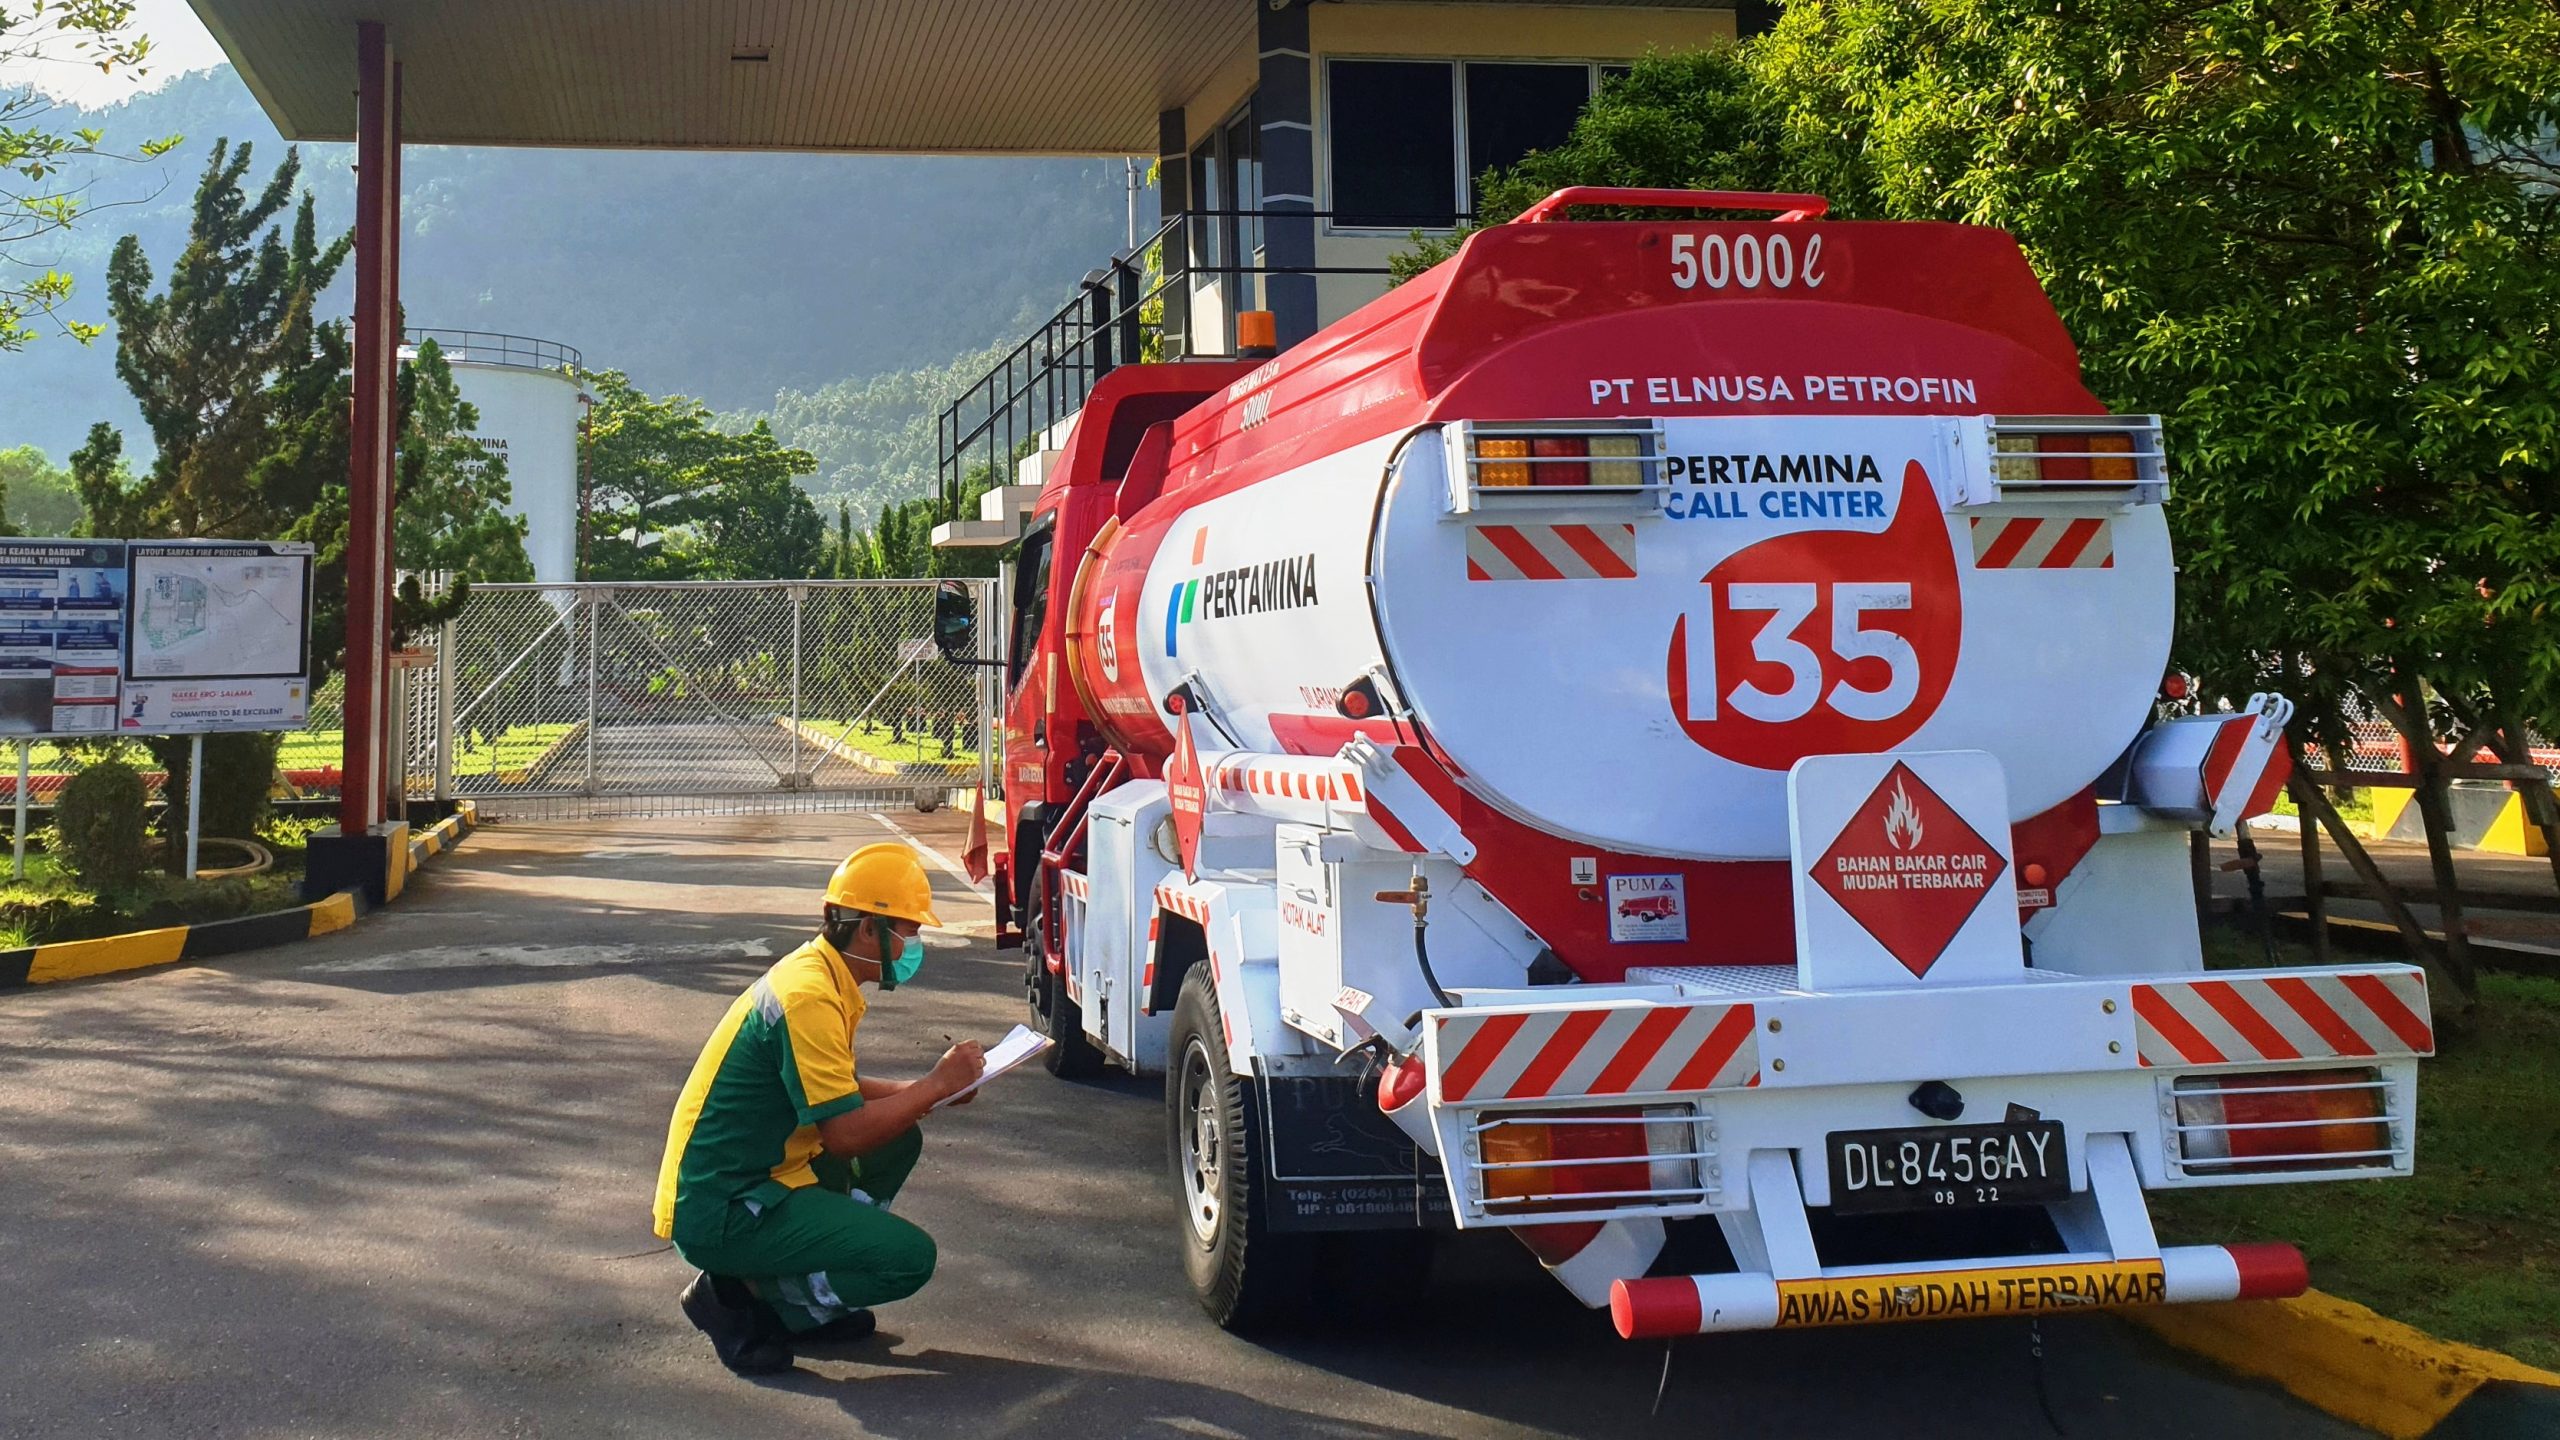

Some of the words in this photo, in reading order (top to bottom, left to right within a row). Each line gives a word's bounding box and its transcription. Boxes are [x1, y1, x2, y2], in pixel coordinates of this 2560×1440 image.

[1590, 378, 1634, 404] PT
[1647, 376, 1794, 403] ELNUSA
[1804, 375, 1977, 404] PETROFIN
[1666, 454, 1883, 485] PERTAMINA
[1664, 491, 1749, 520] CALL
[1758, 490, 1888, 518] CENTER
[9, 547, 46, 556] KEADAAN
[48, 548, 86, 557] DARURAT
[136, 548, 165, 556] LAYOUT
[166, 548, 195, 556] SARFAS
[195, 548, 211, 556] FIRE
[213, 549, 259, 557] PROTECTION
[1203, 553, 1319, 621] PERTAMINA
[1685, 582, 1920, 723] 135
[170, 709, 217, 718] COMMITTED
[219, 709, 230, 717] TO
[231, 708, 241, 716] BE
[242, 707, 283, 716] EXCELLENT
[1837, 856, 1890, 873] BAHAN
[1895, 855, 1947, 871] BAKAR
[1951, 854, 1988, 870] CAIR
[1843, 874, 1898, 890] MUDAH
[1902, 872, 1985, 889] TERBAKAR
[1282, 900, 1305, 931] KOTAK
[1306, 910, 1326, 938] ALAT
[1935, 1191, 1955, 1205] 08
[1976, 1187, 1999, 1203] 22
[1297, 1203, 1321, 1216] HP
[1779, 1288, 1871, 1327] AWAS
[1879, 1280, 1990, 1320] MUDAH
[1998, 1272, 2167, 1311] TERBAKAR
